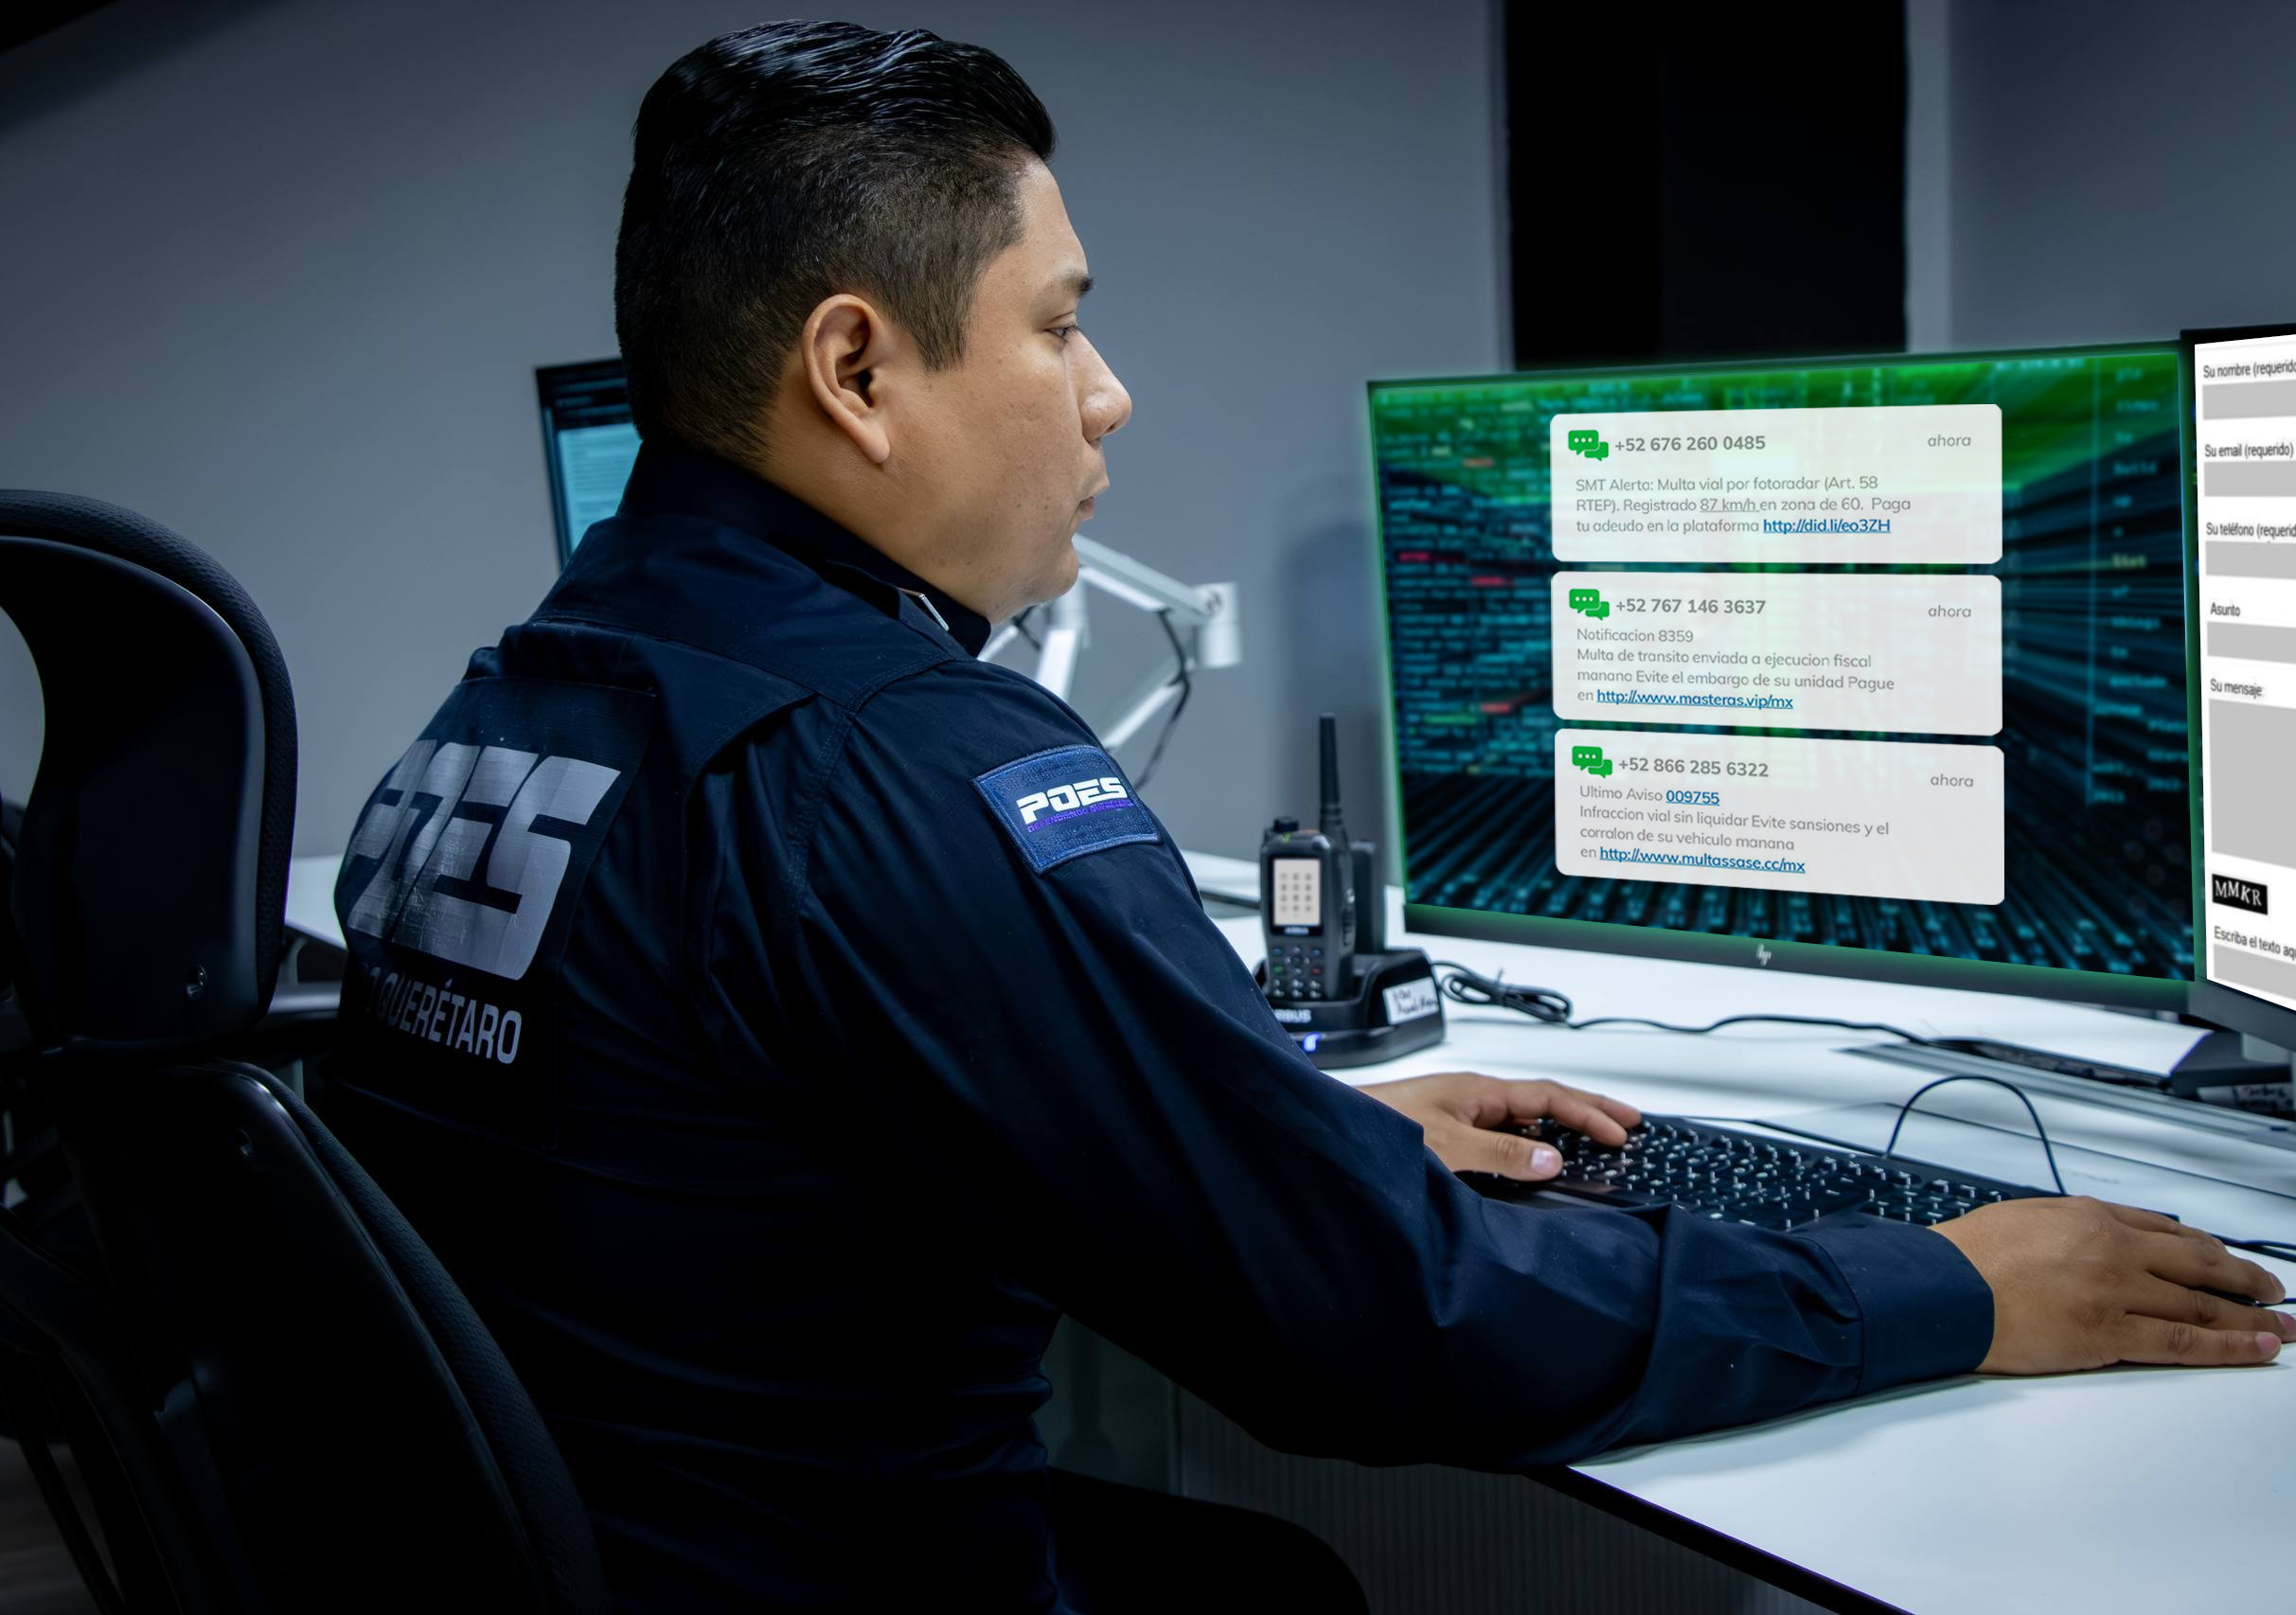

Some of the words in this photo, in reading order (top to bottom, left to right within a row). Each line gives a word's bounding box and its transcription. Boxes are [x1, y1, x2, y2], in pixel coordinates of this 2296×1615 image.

[2203, 365, 2215, 378] Su
[2217, 364, 2251, 377] nombre
[1615, 437, 1646, 452] +52
[1650, 437, 1681, 451] 676
[1686, 436, 1718, 451] 260
[1723, 435, 1766, 451] 0485
[1928, 435, 1971, 447] ahora
[2204, 444, 2216, 457] Su
[2218, 444, 2242, 457] email
[2245, 443, 2294, 458] (requerido)
[1575, 479, 1606, 491] SMT
[1610, 479, 1653, 490] Alerta:
[1658, 479, 1696, 490] Multa
[1700, 478, 1722, 489] vial
[1727, 478, 1750, 492] por
[1753, 476, 1820, 489] fotoradar
[1824, 476, 1855, 491] (Art.
[1860, 476, 1878, 488] 58
[1576, 499, 1620, 513] RTEP).
[1624, 499, 1697, 514] Registrado
[1700, 498, 1718, 512] 87
[1722, 498, 1756, 512] km/h
[1759, 501, 1776, 510] en
[1781, 499, 1815, 510] zona
[1820, 498, 1837, 510] de
[1842, 497, 1863, 510] 60.
[1872, 497, 1911, 513] Paga
[1576, 521, 1590, 532] tu
[1593, 520, 1644, 532] adeudo
[1647, 522, 1664, 532] en
[1667, 520, 1679, 532] la
[1683, 519, 1759, 534] plataforma
[1763, 519, 1891, 534] http://did.li/eo3ZH
[2206, 523, 2218, 536] Su
[2220, 523, 2253, 536] teléfono
[1616, 598, 1646, 612] +52
[1651, 599, 1682, 612] 767
[1688, 599, 1718, 613] 146
[1723, 600, 1766, 613] 3637
[1928, 605, 1971, 617] ahora
[2210, 602, 2240, 616] Asunto
[1577, 629, 1654, 641] Notificacion
[1658, 630, 1694, 642] 8359
[1577, 648, 1613, 661] Multa
[1618, 649, 1634, 662] de
[1638, 650, 1689, 663] transito
[1692, 651, 1748, 665] enviada
[1752, 655, 1761, 665] a
[1765, 652, 1830, 668] ejecucion
[1833, 653, 1872, 667] fiscal
[1577, 671, 1632, 683] manana
[1636, 671, 1669, 683] Evite
[1672, 671, 1683, 683] el
[1687, 673, 1749, 688] embargo
[1753, 674, 1770, 686] de
[1774, 676, 1789, 686] su
[1794, 675, 1844, 688] unidad
[1848, 676, 1895, 692] Pague
[2210, 679, 2222, 692] Su
[2225, 683, 2265, 699] mensaje:
[1577, 690, 1593, 701] en
[1619, 757, 1649, 772] +52
[1654, 758, 1684, 773] 866
[1690, 760, 1721, 774] 285
[1726, 762, 1769, 777] 6322
[1931, 774, 1974, 788] ahora
[1016, 777, 1128, 825] POES
[1580, 786, 1622, 799] Ultimo
[1627, 789, 1663, 801] Aviso
[1666, 790, 1720, 806] 009755
[1580, 806, 1644, 821] Infraccion
[1647, 809, 1670, 823] vial
[1674, 811, 1693, 824] sin
[1697, 811, 1748, 827] liquidar
[1752, 815, 1786, 829] Evite
[1789, 819, 1860, 833] sansiones
[1864, 824, 1873, 837] y
[1877, 823, 1889, 835] el
[1580, 826, 1634, 841] corralon
[1637, 829, 1654, 842] de
[1658, 832, 1673, 843] su
[1677, 832, 1732, 846] vehiculo
[1735, 837, 1795, 850] manana
[1580, 847, 1596, 859] en
[2216, 879, 2261, 906] MMKR
[2215, 926, 2247, 946] Escriba
[2250, 936, 2257, 949] el
[2259, 937, 2281, 954] texto
[380, 971, 523, 1065] QUERÉTARO
